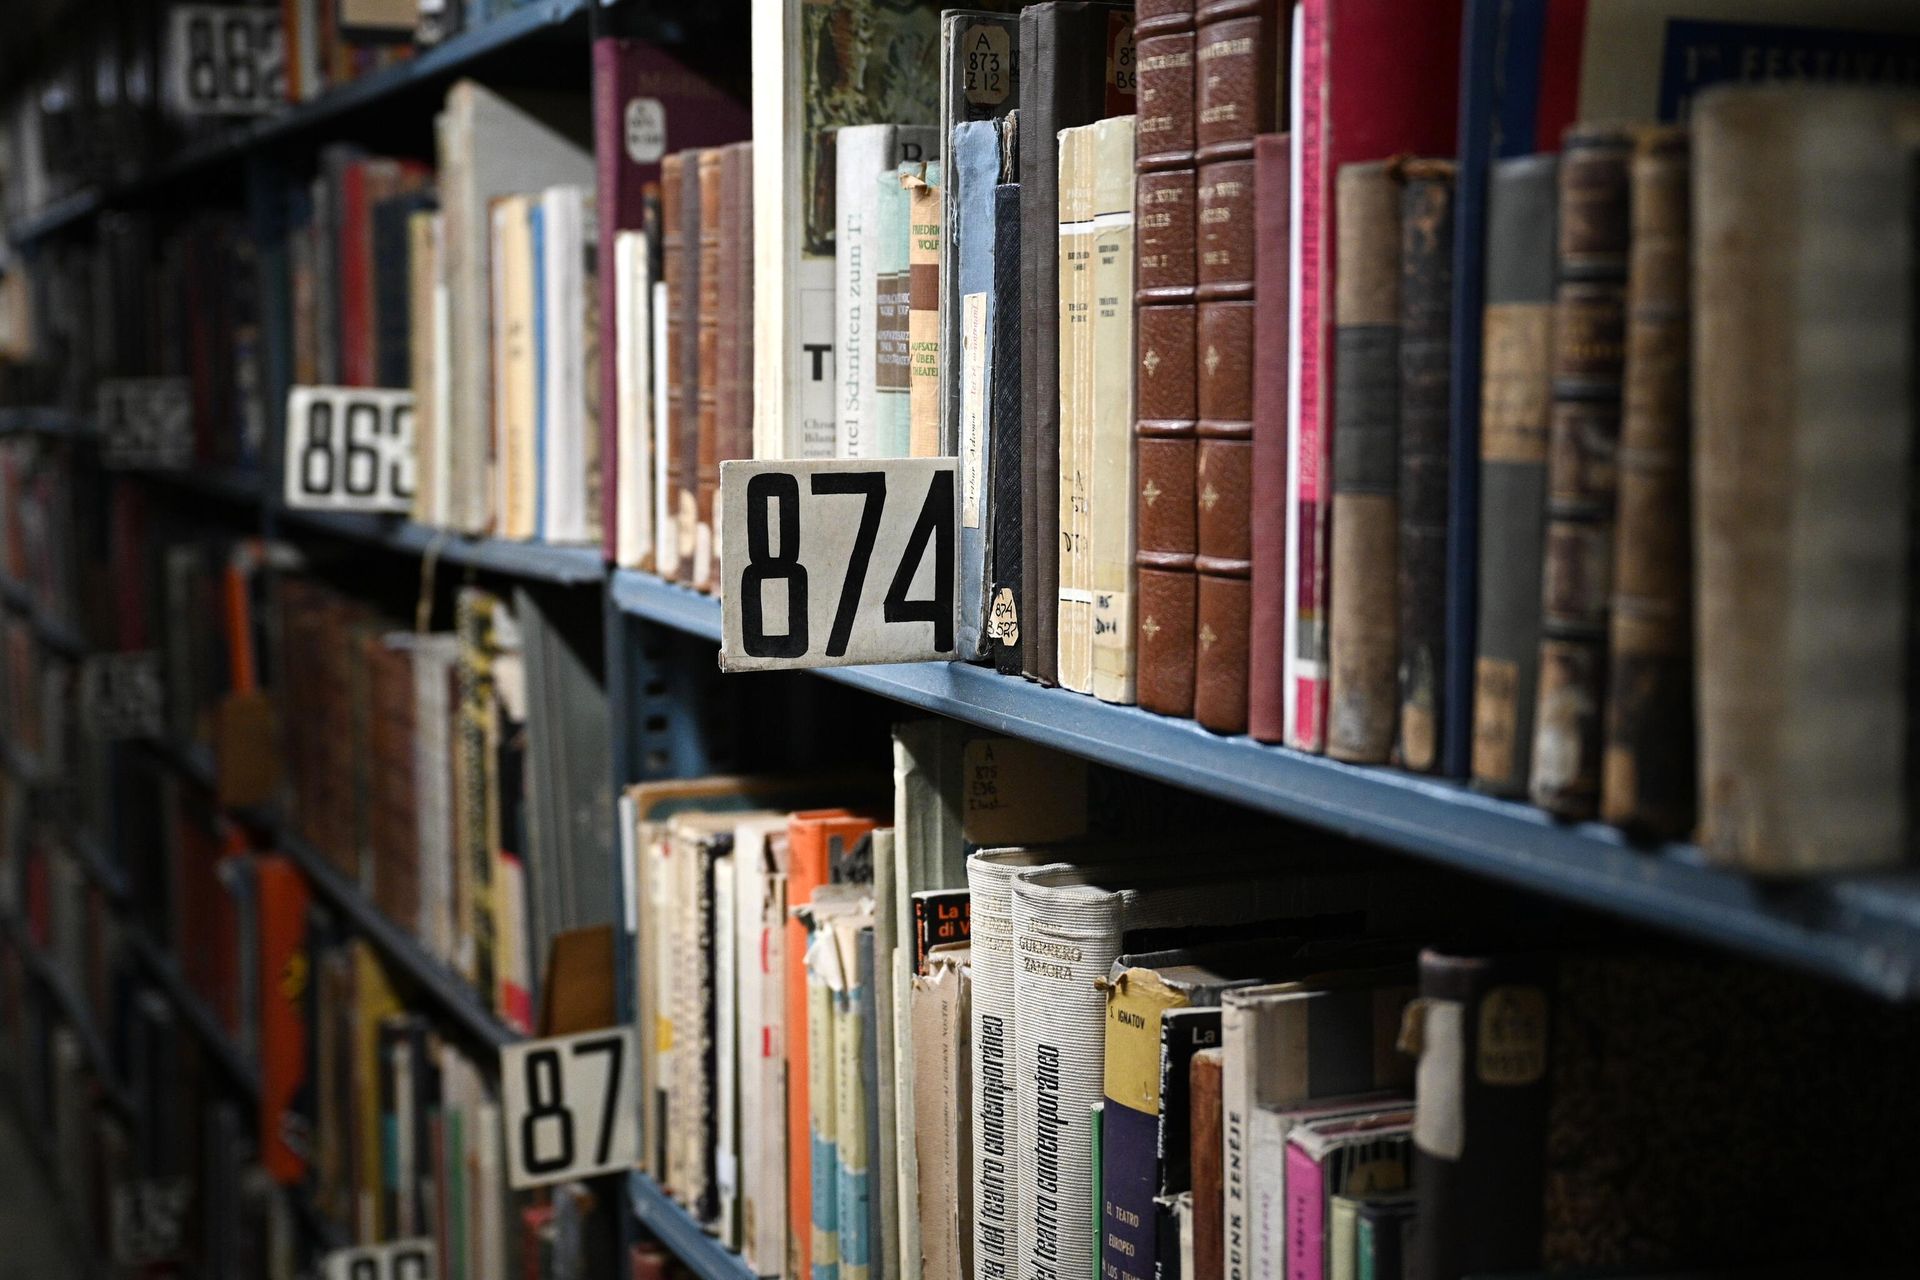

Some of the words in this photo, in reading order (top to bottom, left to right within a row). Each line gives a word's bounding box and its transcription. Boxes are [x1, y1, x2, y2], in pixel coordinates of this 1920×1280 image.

[976, 33, 991, 50] A
[969, 53, 1000, 72] 873
[803, 343, 832, 381] T
[741, 469, 955, 659] 874
[995, 599, 1013, 619] 874
[938, 904, 959, 920] La
[938, 921, 954, 937] di
[1117, 1009, 1146, 1030] IGNATOV
[1192, 1027, 1216, 1044] La
[522, 1036, 625, 1176] 87
[1034, 1043, 1069, 1194] contemporáneo
[980, 1158, 1005, 1222] teatro
[1032, 1194, 1058, 1263] teatro
[1115, 1205, 1140, 1229] TEATRO
[979, 1222, 1005, 1257] del
[1108, 1234, 1135, 1257] EUROPEO
